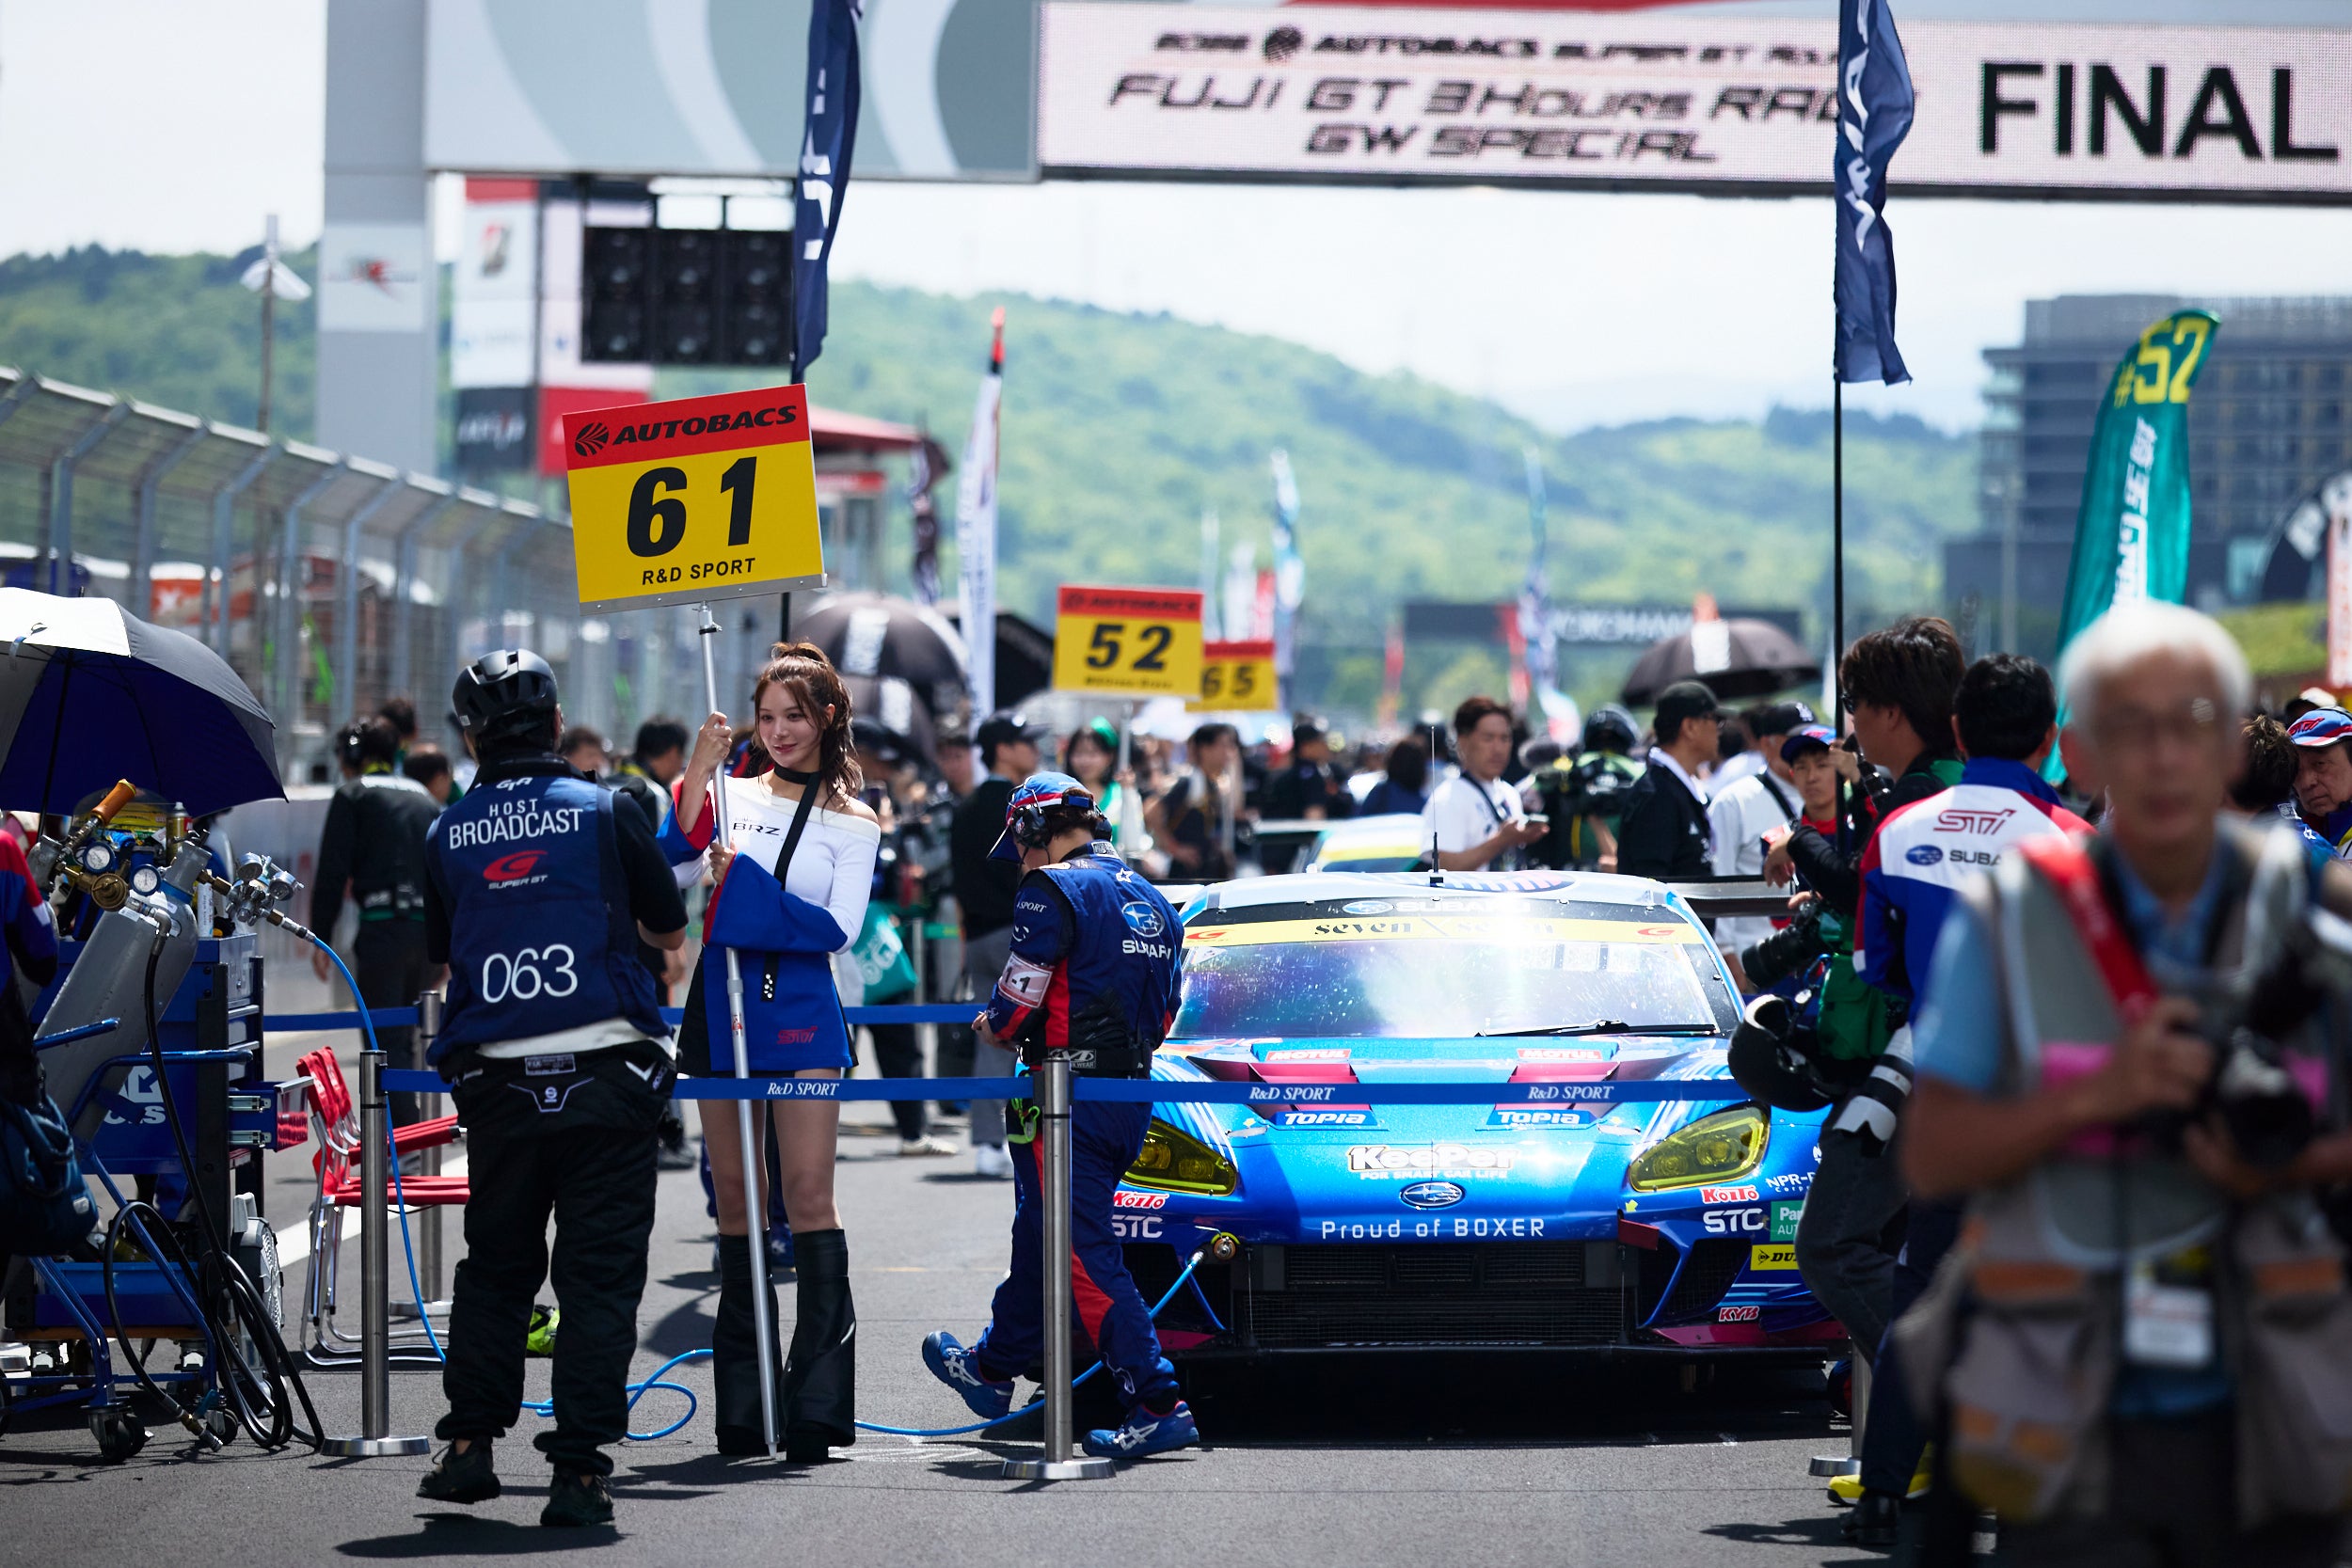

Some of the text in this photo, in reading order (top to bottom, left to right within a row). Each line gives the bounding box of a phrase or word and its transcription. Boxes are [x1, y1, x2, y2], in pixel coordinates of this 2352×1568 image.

[1109, 72, 1288, 109] FUJI
[1305, 78, 1410, 112] GT
[1979, 60, 2341, 161] FINAL
[1427, 124, 1718, 163] SPECIAL
[612, 404, 798, 447] AUTOBACS
[625, 455, 758, 558] 61
[642, 557, 756, 586] R&D SPORT
[1086, 623, 1174, 672] 52
[489, 799, 538, 817] HOST
[449, 808, 584, 850] BROADCAST
[733, 822, 781, 836] BRZ
[488, 877, 529, 890] SUPER
[482, 942, 579, 1004] 063
[1270, 1049, 1347, 1061] MOTUL
[1518, 1049, 1600, 1060] MOTUL
[767, 1083, 839, 1096] R&D SPORT
[1249, 1086, 1336, 1101] R&D SPORT
[1528, 1085, 1614, 1100] R&D SPORT
[1322, 1218, 1545, 1240] Proud of BOXER
[1703, 1208, 1763, 1233] STC
[1719, 1306, 1760, 1323] KYB
